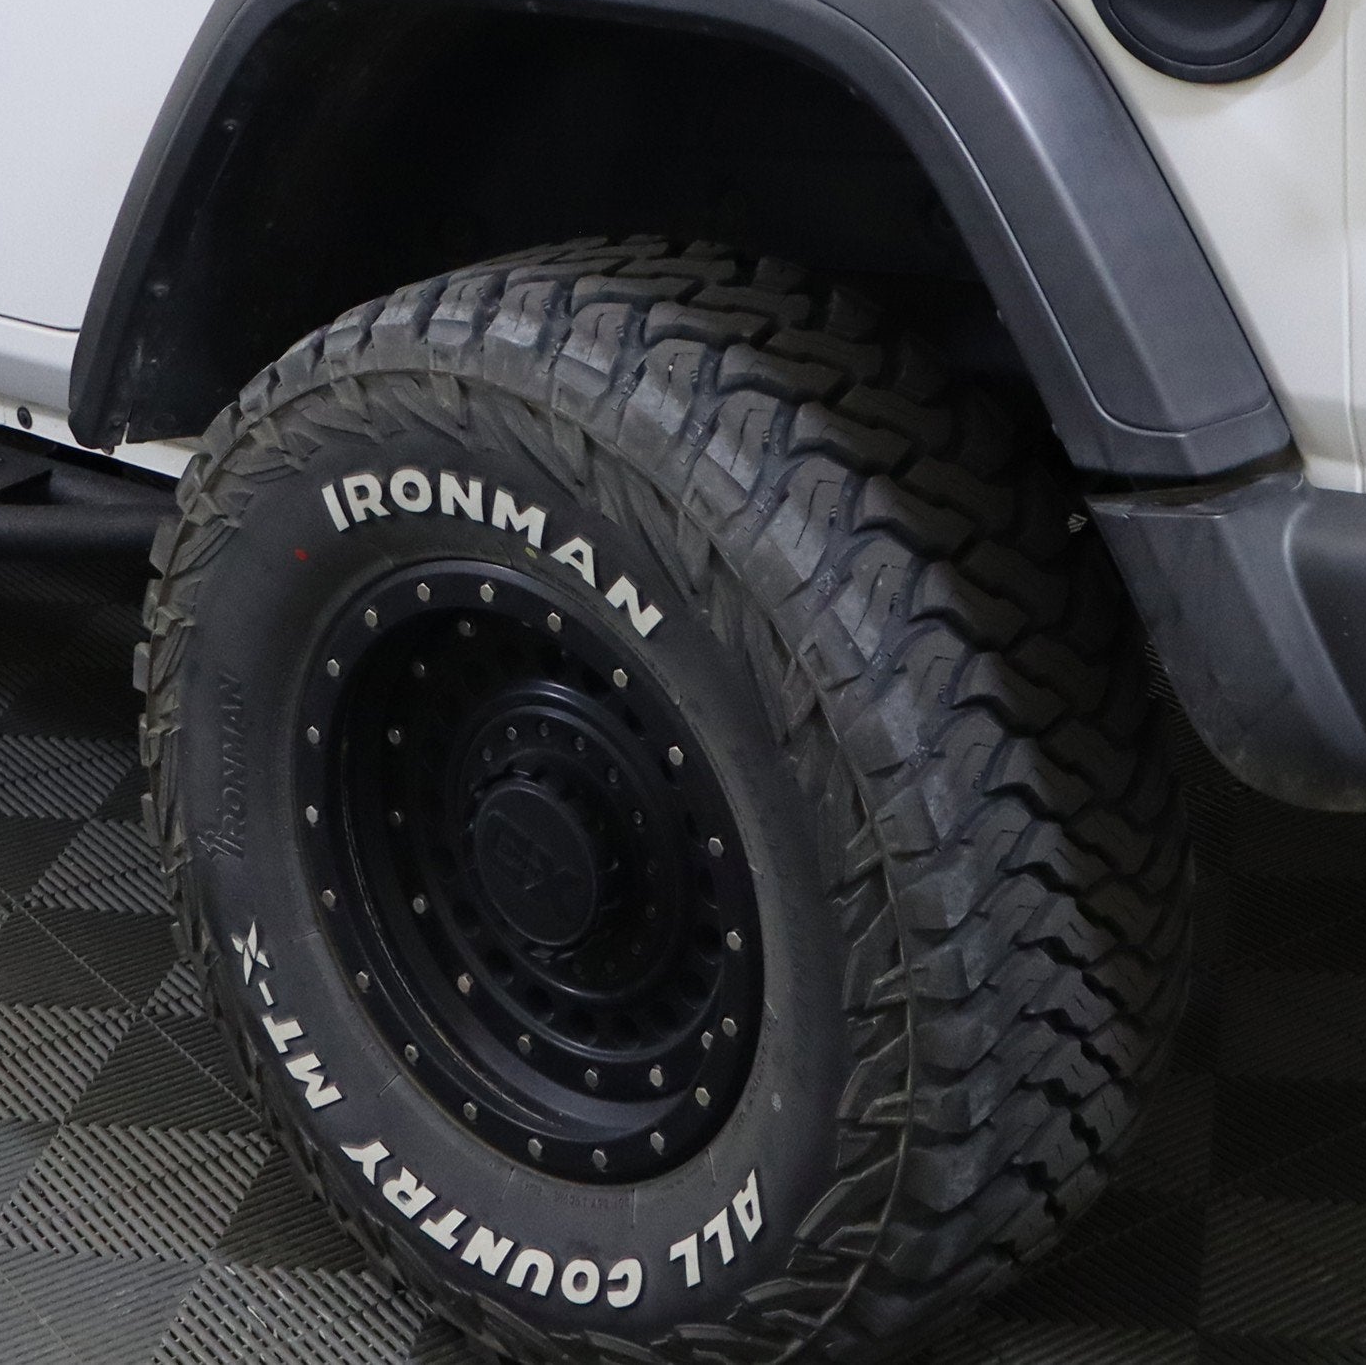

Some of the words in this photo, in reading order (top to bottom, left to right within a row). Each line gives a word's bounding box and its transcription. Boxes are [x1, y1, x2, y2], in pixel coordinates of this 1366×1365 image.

[321, 468, 664, 638] IRONMAN
[231, 920, 344, 1110] MT-X
[340, 1139, 644, 1309] COUNTRY
[669, 1169, 764, 1289] ALL
